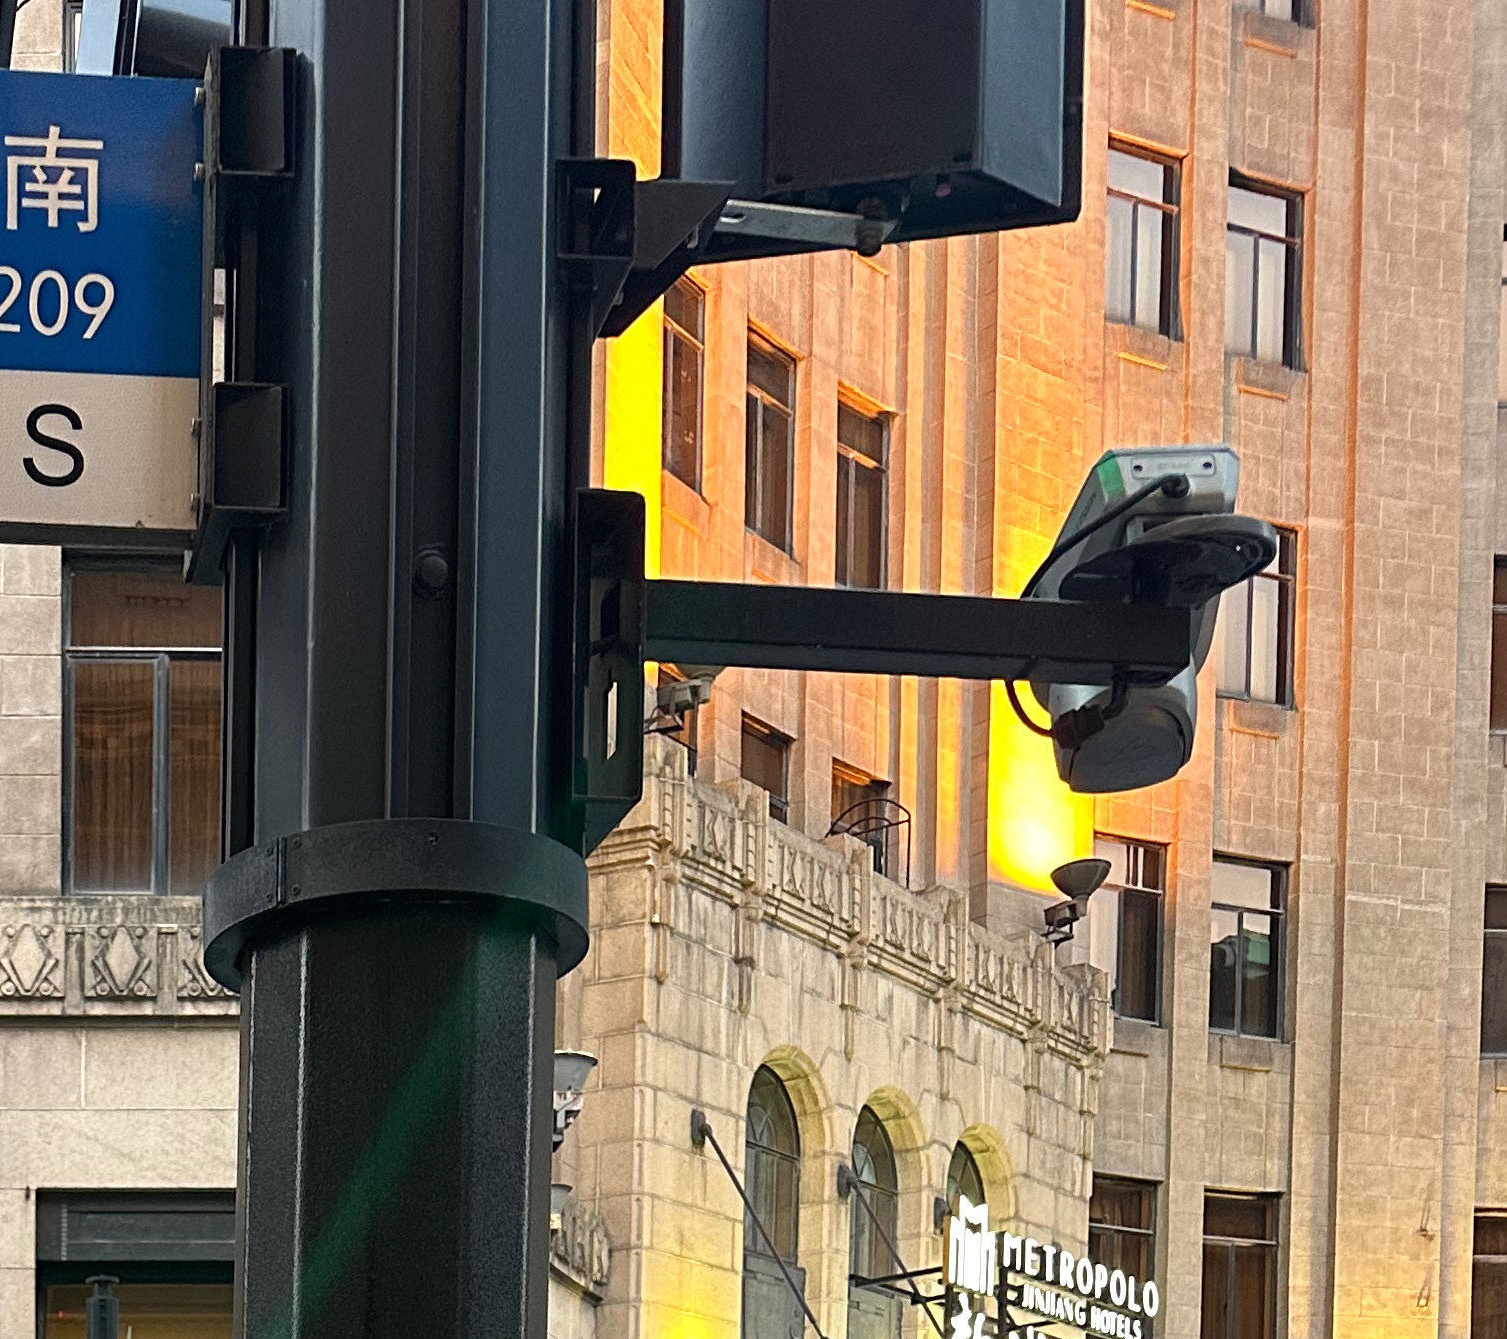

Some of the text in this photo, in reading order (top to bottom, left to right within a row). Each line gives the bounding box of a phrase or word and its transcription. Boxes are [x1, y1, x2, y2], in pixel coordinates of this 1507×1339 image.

[4, 125, 104, 233] 南
[22, 403, 85, 488] S
[1002, 1231, 1160, 1318] METROPOLO
[1022, 1283, 1087, 1327] JINJIANG
